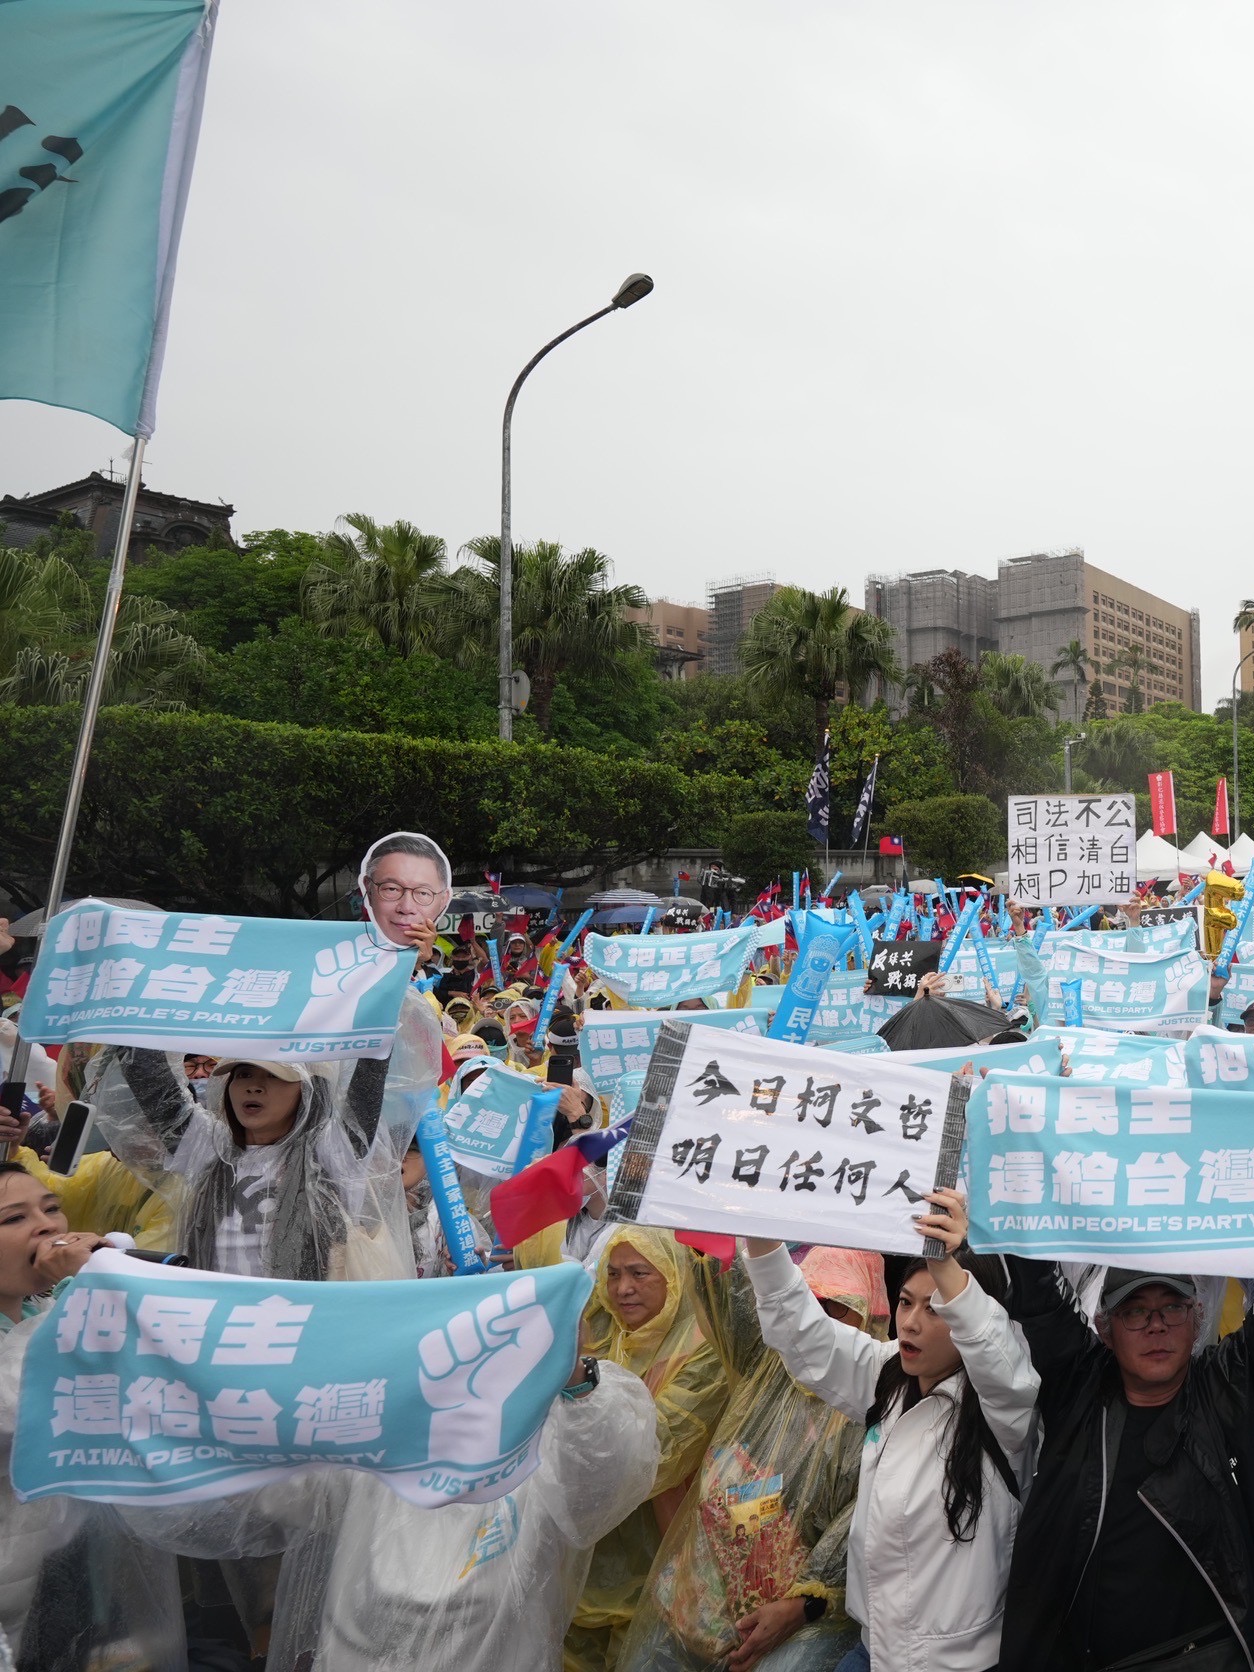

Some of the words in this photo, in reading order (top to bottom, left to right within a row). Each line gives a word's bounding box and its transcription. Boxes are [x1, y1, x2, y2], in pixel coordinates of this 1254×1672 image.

[1014, 798, 1132, 831] 司法不公
[1011, 832, 1131, 865] 相信清白
[1013, 868, 1131, 900] 柯P加油
[55, 909, 242, 955] 把民主
[46, 957, 292, 1008] 還給台灣
[883, 970, 920, 990] 戰獨
[92, 1005, 190, 1022] PEOPLE'S
[195, 1010, 272, 1026] PARTY
[1122, 1005, 1154, 1014] PARTY
[1158, 1017, 1202, 1027] JUSTICE
[279, 1038, 383, 1053] JUSTICE
[588, 1026, 657, 1050] 把民
[685, 1059, 933, 1141] 今日柯文哲
[987, 1083, 1193, 1136] 把民主
[455, 1134, 496, 1151] PARTY
[671, 1133, 926, 1206] 明日任何人
[434, 1141, 479, 1267] 民主國家政治追殺
[989, 1215, 1069, 1232] TAIWAN
[1072, 1215, 1183, 1232] PEOPLE'S
[56, 1288, 314, 1366] 把民主
[49, 1373, 388, 1447] 還給台灣
[417, 1446, 530, 1493] JUSTICE
